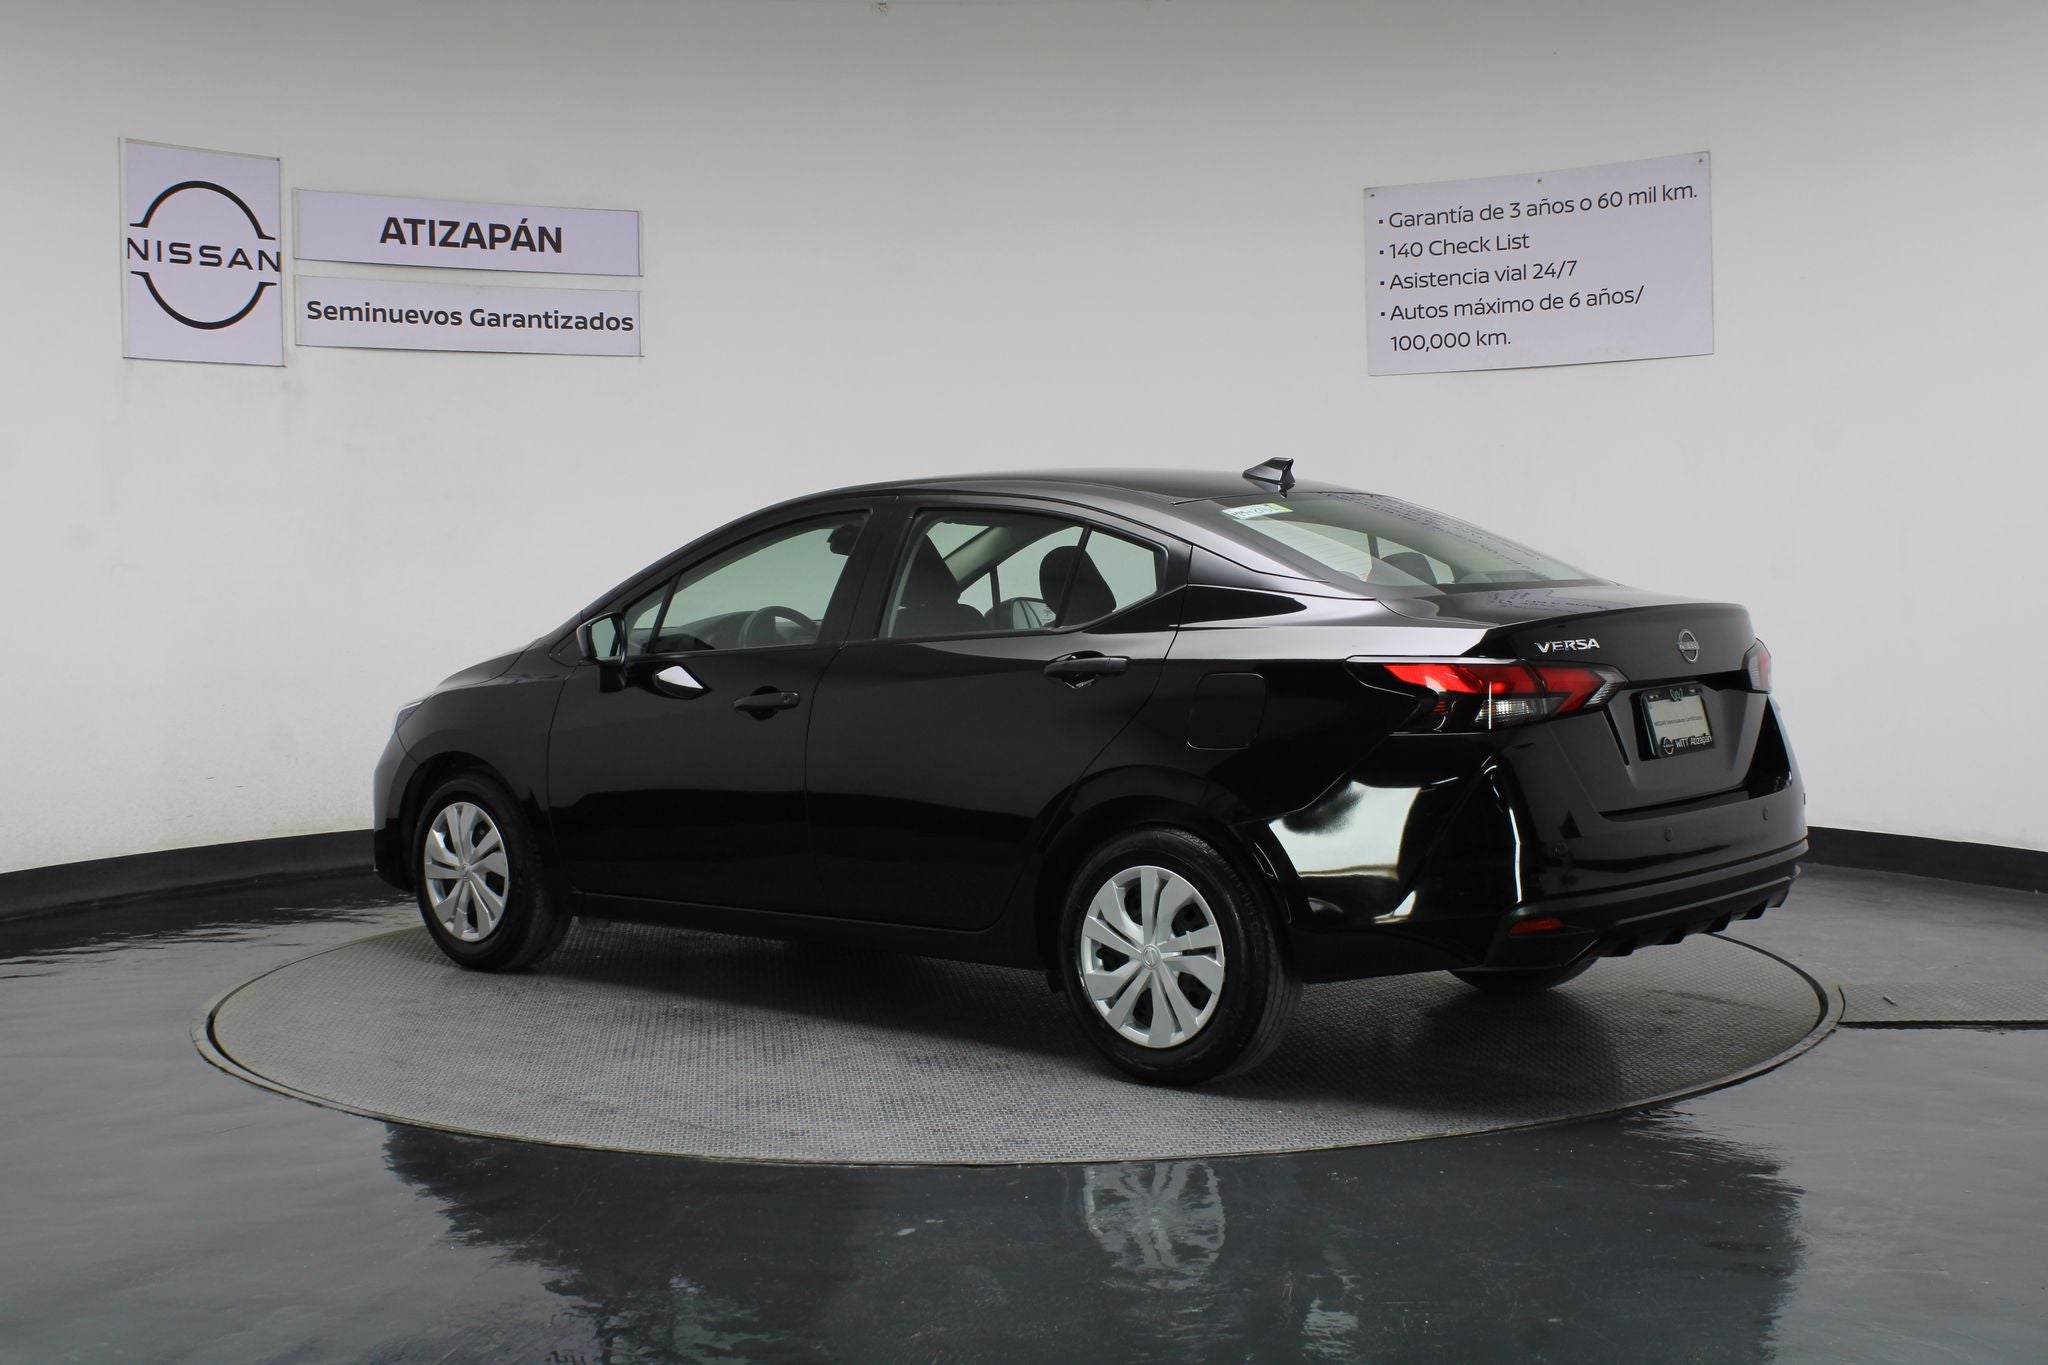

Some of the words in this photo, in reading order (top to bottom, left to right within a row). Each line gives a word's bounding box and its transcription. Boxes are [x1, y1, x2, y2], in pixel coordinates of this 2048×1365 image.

[1388, 206, 1474, 229] Garantía
[1479, 203, 1505, 221] de
[1509, 202, 1521, 219] 3
[1526, 198, 1575, 217] años
[1579, 197, 1593, 212] o
[1597, 191, 1623, 210] 60
[1628, 185, 1657, 206] mil
[1662, 184, 1697, 202] km.
[379, 216, 562, 254] ATIZAPÁN
[1388, 241, 1424, 259] 140
[1428, 235, 1491, 256] Check
[1496, 233, 1530, 251] List
[127, 237, 281, 273] NISSAN
[1389, 268, 1490, 290] Asistencia
[1493, 263, 1527, 283] vial
[1532, 260, 1578, 280] 24/7
[307, 300, 463, 327] Seminuevos
[469, 308, 634, 332] Garantizados
[1389, 303, 1449, 321] Autos
[1454, 297, 1535, 318] máximo
[1539, 293, 1564, 311] de
[1569, 291, 1581, 308] 6
[1586, 284, 1645, 307] años/
[1390, 331, 1471, 353] 100,000
[1476, 330, 1511, 347] km.
[1534, 637, 1600, 653] VERSA
